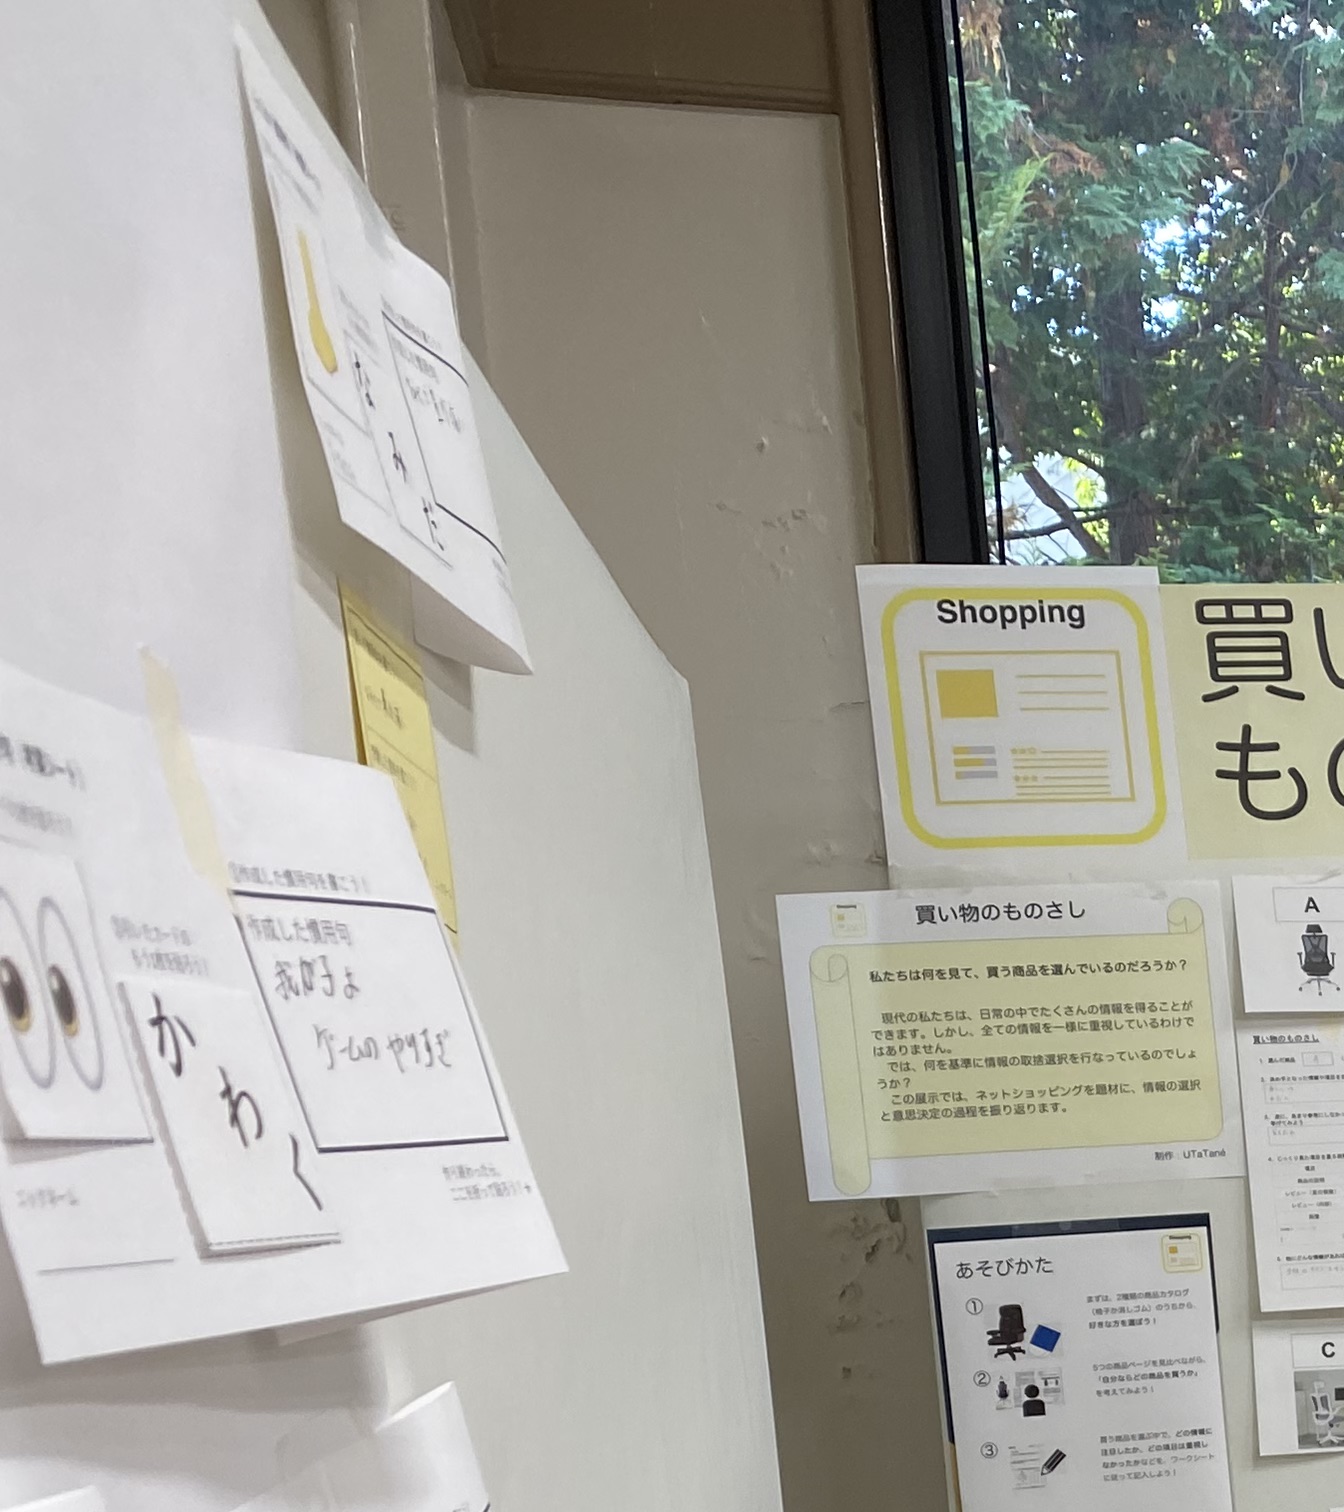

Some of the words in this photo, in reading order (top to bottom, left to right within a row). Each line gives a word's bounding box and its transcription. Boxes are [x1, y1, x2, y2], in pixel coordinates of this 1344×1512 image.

[936, 598, 1085, 631] Shopping
[915, 900, 1087, 925] 買い物のものさし
[1304, 896, 1321, 913] A
[869, 958, 1188, 983] 私たちは何を見て、買う商品を選んでいるのだろうか？
[880, 1000, 1194, 1025] 現代の私たちは、日常の中でたくさんの情報を得ることが
[872, 1043, 955, 1058] はありません。
[876, 1077, 912, 1091] うか？
[955, 1256, 1054, 1280] あそびかた
[1320, 1341, 1336, 1358] C
